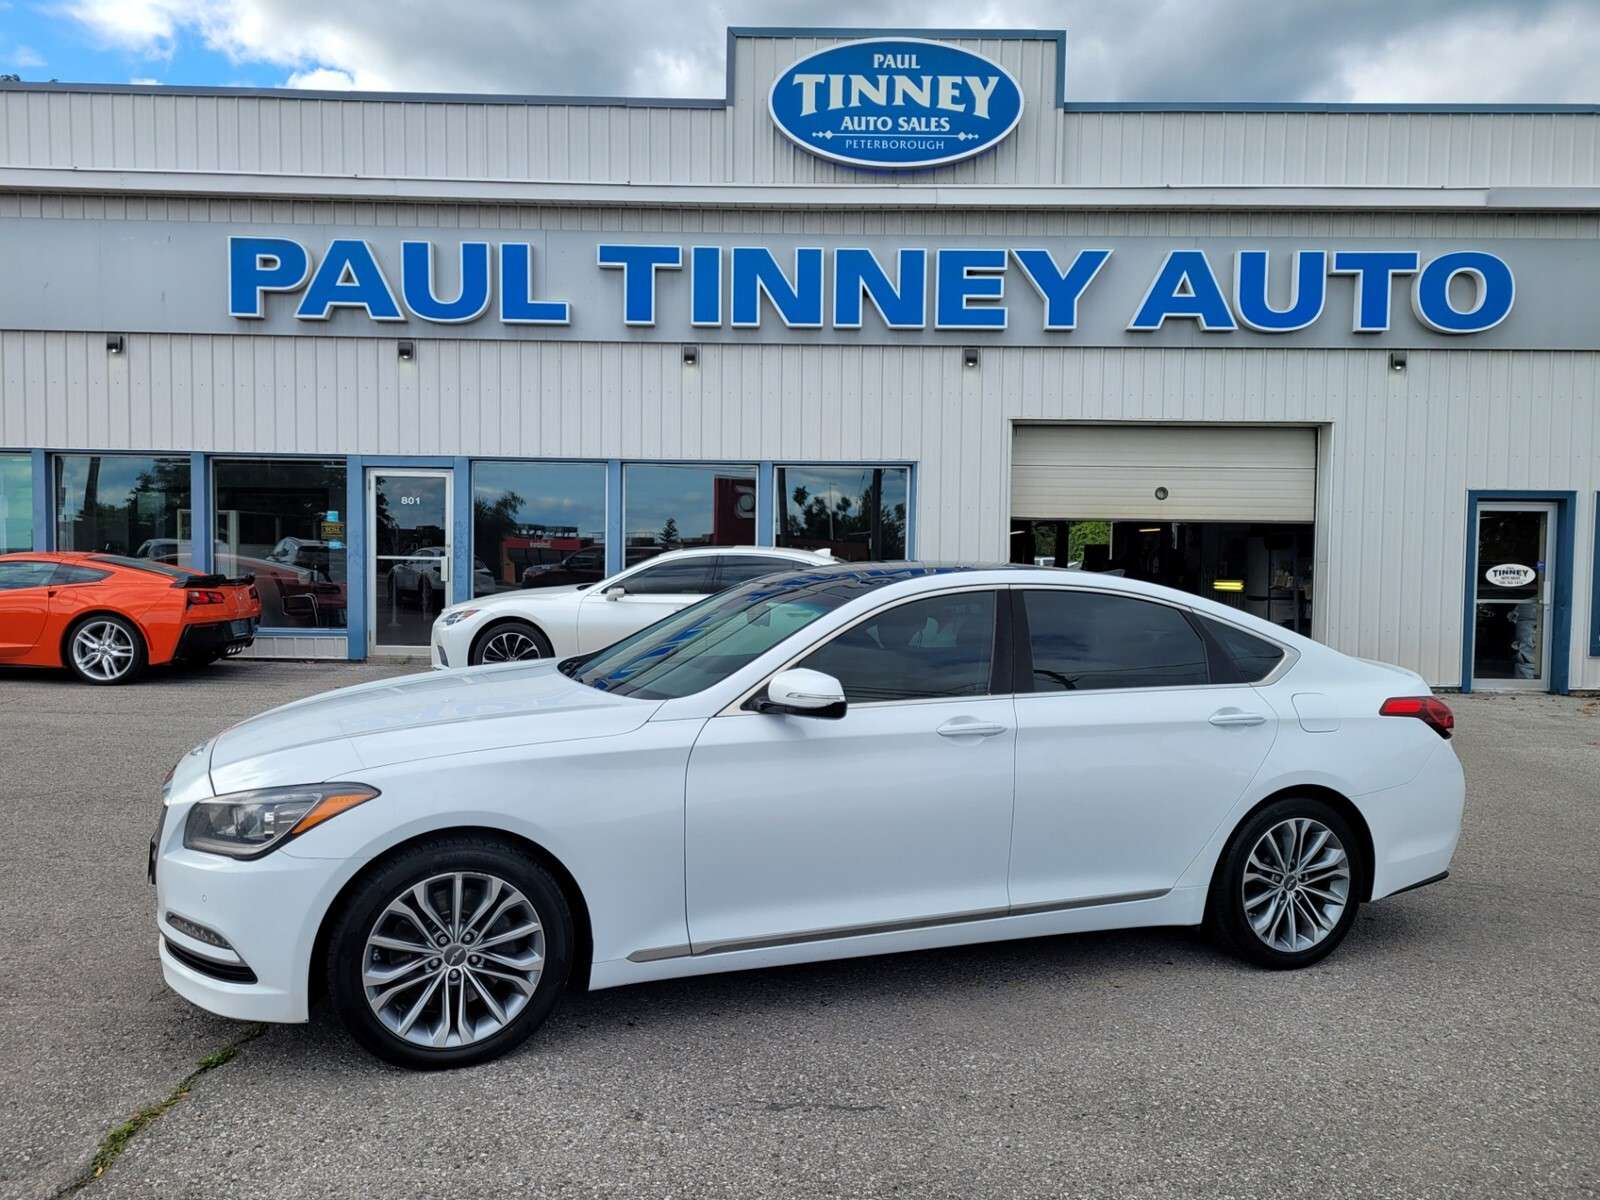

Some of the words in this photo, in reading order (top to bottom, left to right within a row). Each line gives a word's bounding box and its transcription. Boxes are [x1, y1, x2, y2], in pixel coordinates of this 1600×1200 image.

[873, 54, 920, 69] PAUL
[793, 73, 1000, 120] TINNEY
[840, 116, 892, 131] AUTO
[898, 117, 950, 132] SALES
[845, 139, 945, 150] PETERBOROUGH
[228, 235, 571, 325] PAUL
[596, 244, 1114, 330] TINNEY
[1126, 250, 1516, 334] AUTO
[400, 496, 420, 505] 801
[1492, 569, 1529, 578] TINNEY
